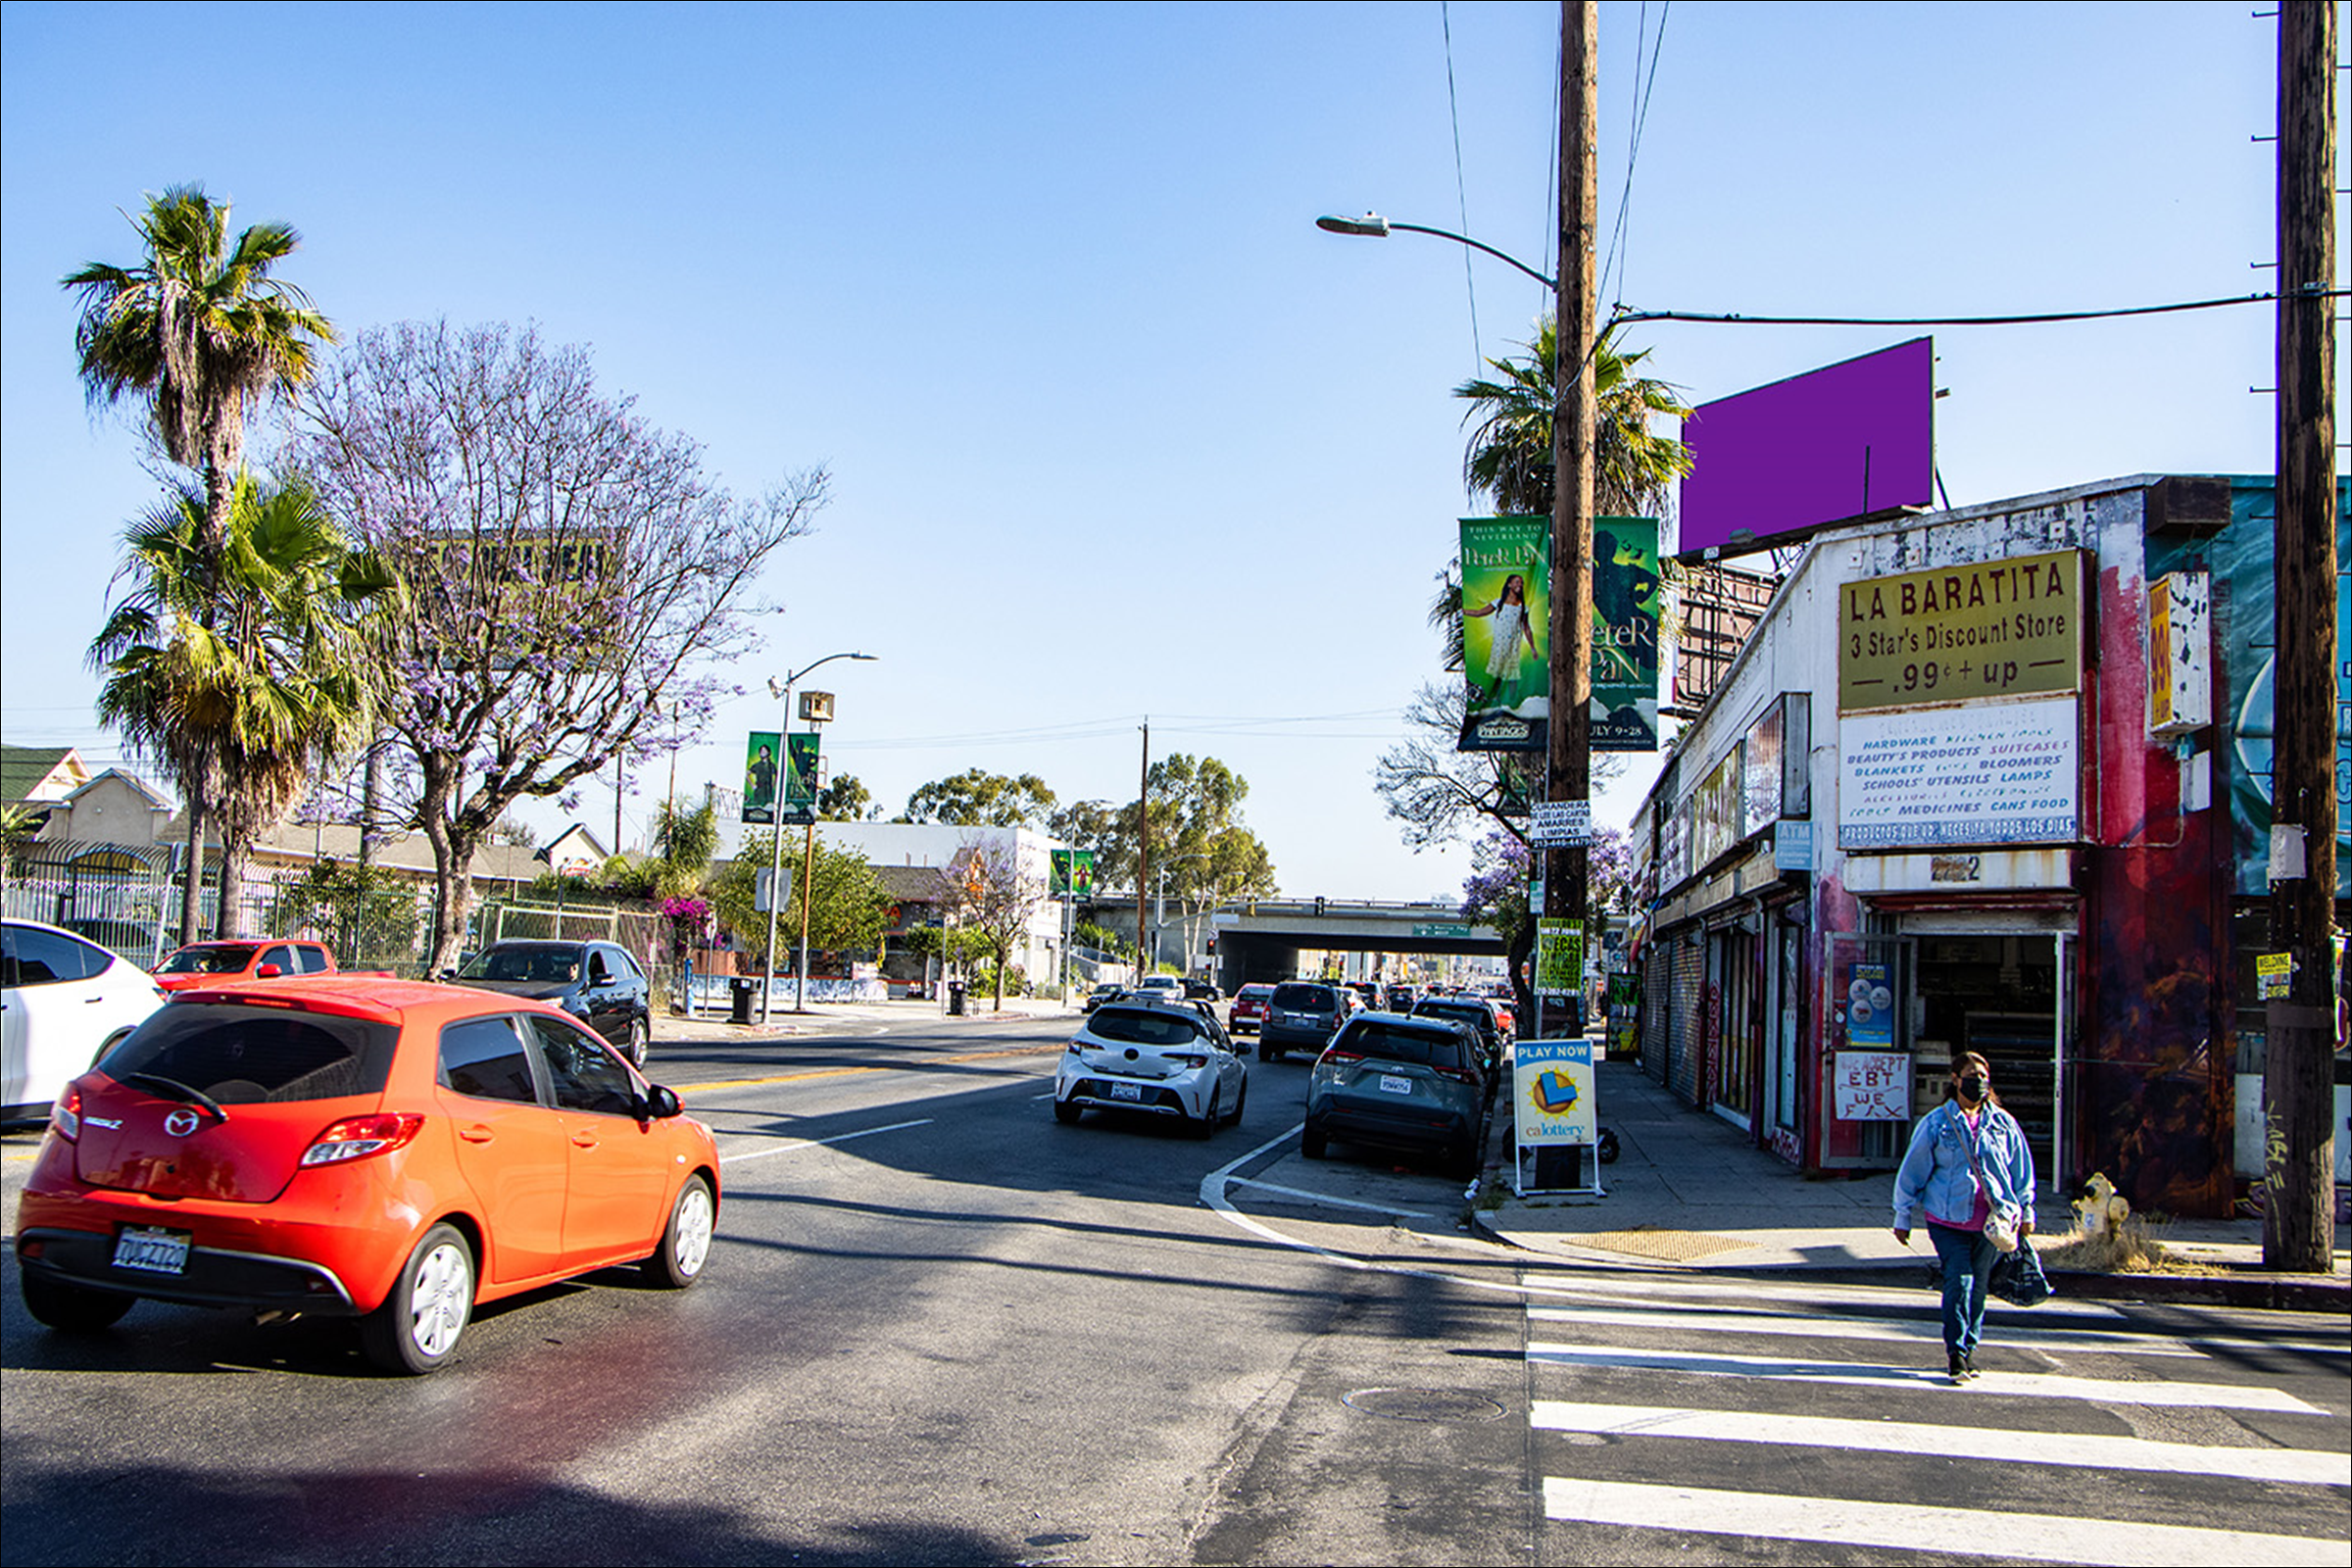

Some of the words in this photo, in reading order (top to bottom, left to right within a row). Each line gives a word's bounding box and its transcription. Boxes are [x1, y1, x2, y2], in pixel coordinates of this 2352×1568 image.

[1473, 532, 1539, 541] NEVERLAND
[1850, 587, 1886, 622] LA
[1901, 561, 2065, 616] BARATITA
[1591, 616, 1655, 646] eteR
[1851, 633, 1861, 660] 3
[1868, 627, 1918, 658] Star's
[1926, 617, 2008, 650] Discount
[2015, 613, 2066, 640] Store
[1984, 661, 2018, 686] up
[1863, 736, 1936, 750] HARDWARE
[1847, 752, 1907, 764] BEAUTY'S
[1911, 746, 1981, 760] PRODUCTS
[1989, 740, 2069, 755] SUITCASES
[1854, 764, 1925, 777] BLANKETS
[1980, 755, 2063, 769] BLOOMERS
[1927, 773, 1991, 787] UTENSILS
[2000, 769, 2052, 783] LAMPS
[1898, 803, 1982, 815] MEDICINES
[1990, 800, 2027, 811] CANS
[2031, 798, 2069, 809] FOOD
[1780, 824, 1810, 839] ATM
[2259, 955, 2289, 968] WELDING
[1518, 1047, 1552, 1058] PLAY
[1557, 1046, 1588, 1057] NOW
[1849, 1071, 1893, 1086] EBT
[1854, 1093, 1886, 1105] WE
[1844, 1104, 1903, 1117] FAX
